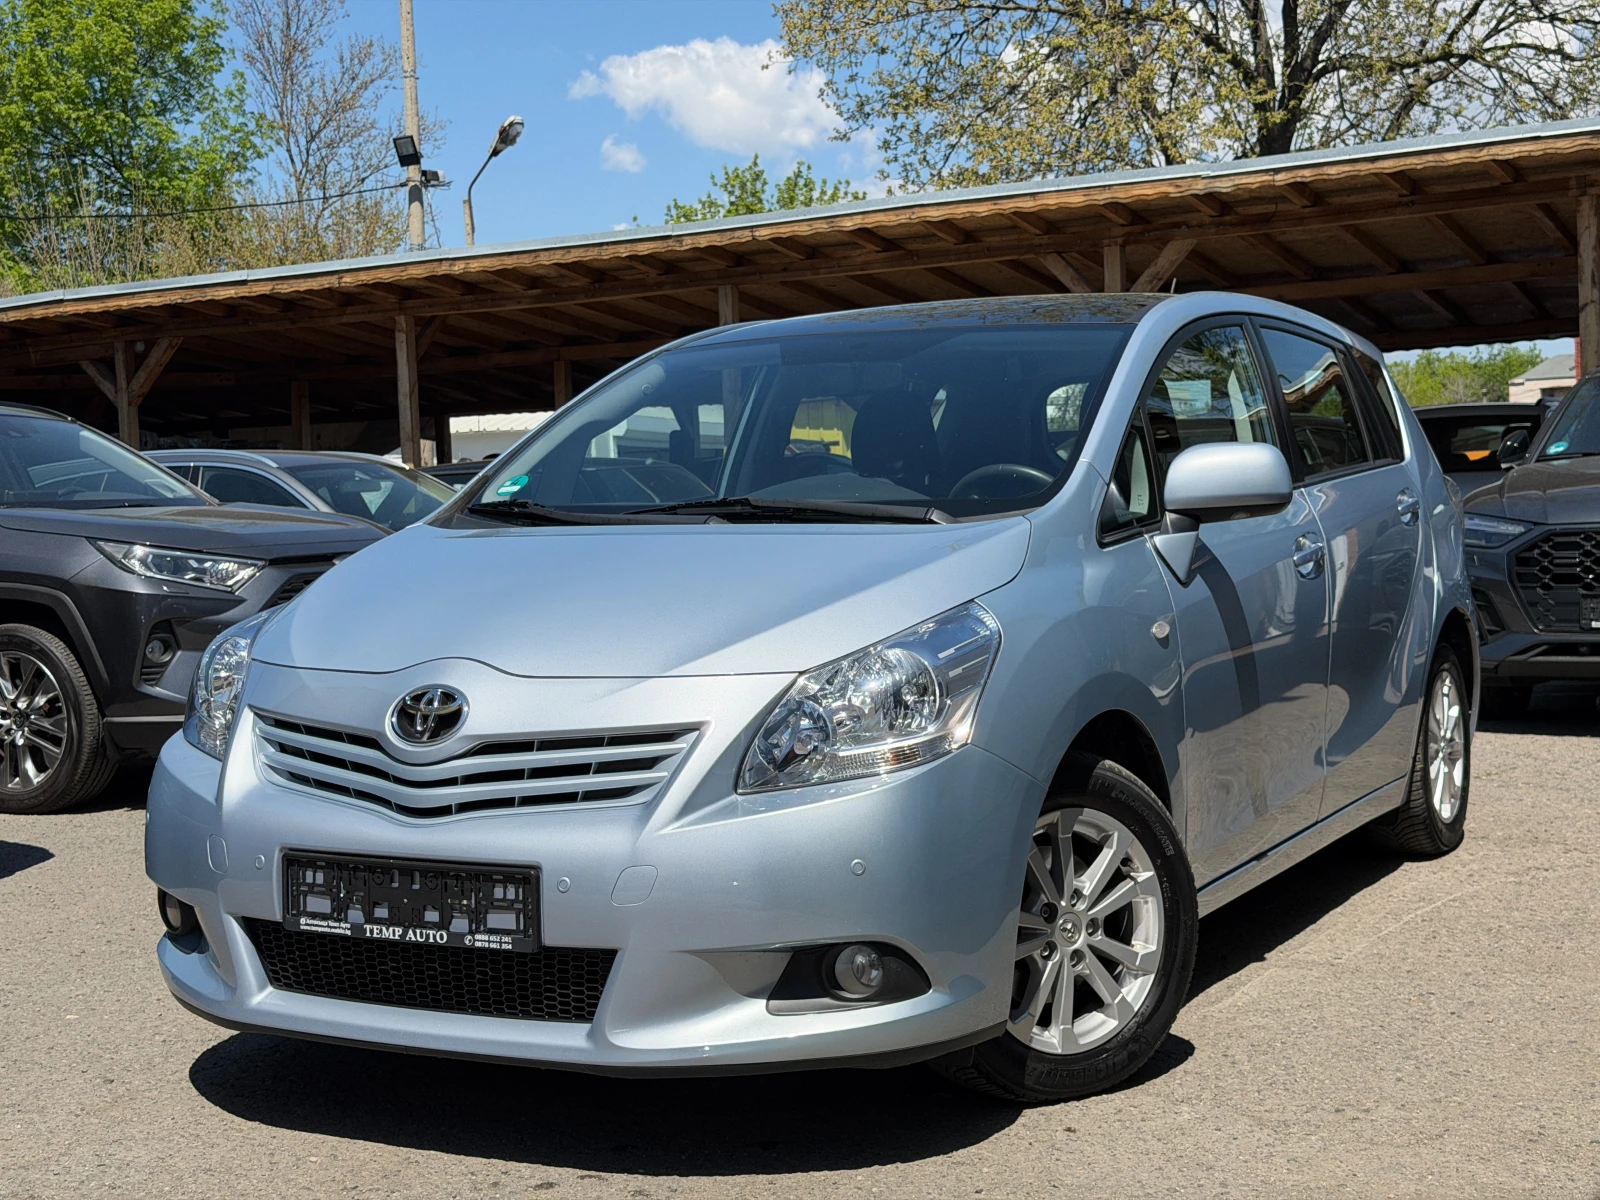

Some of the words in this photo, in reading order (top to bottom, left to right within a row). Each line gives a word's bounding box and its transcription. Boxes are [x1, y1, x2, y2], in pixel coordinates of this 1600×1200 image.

[1115, 789, 1175, 857] CROSSCLIMATE
[363, 924, 403, 940] TEMP
[405, 929, 448, 944] AUTO
